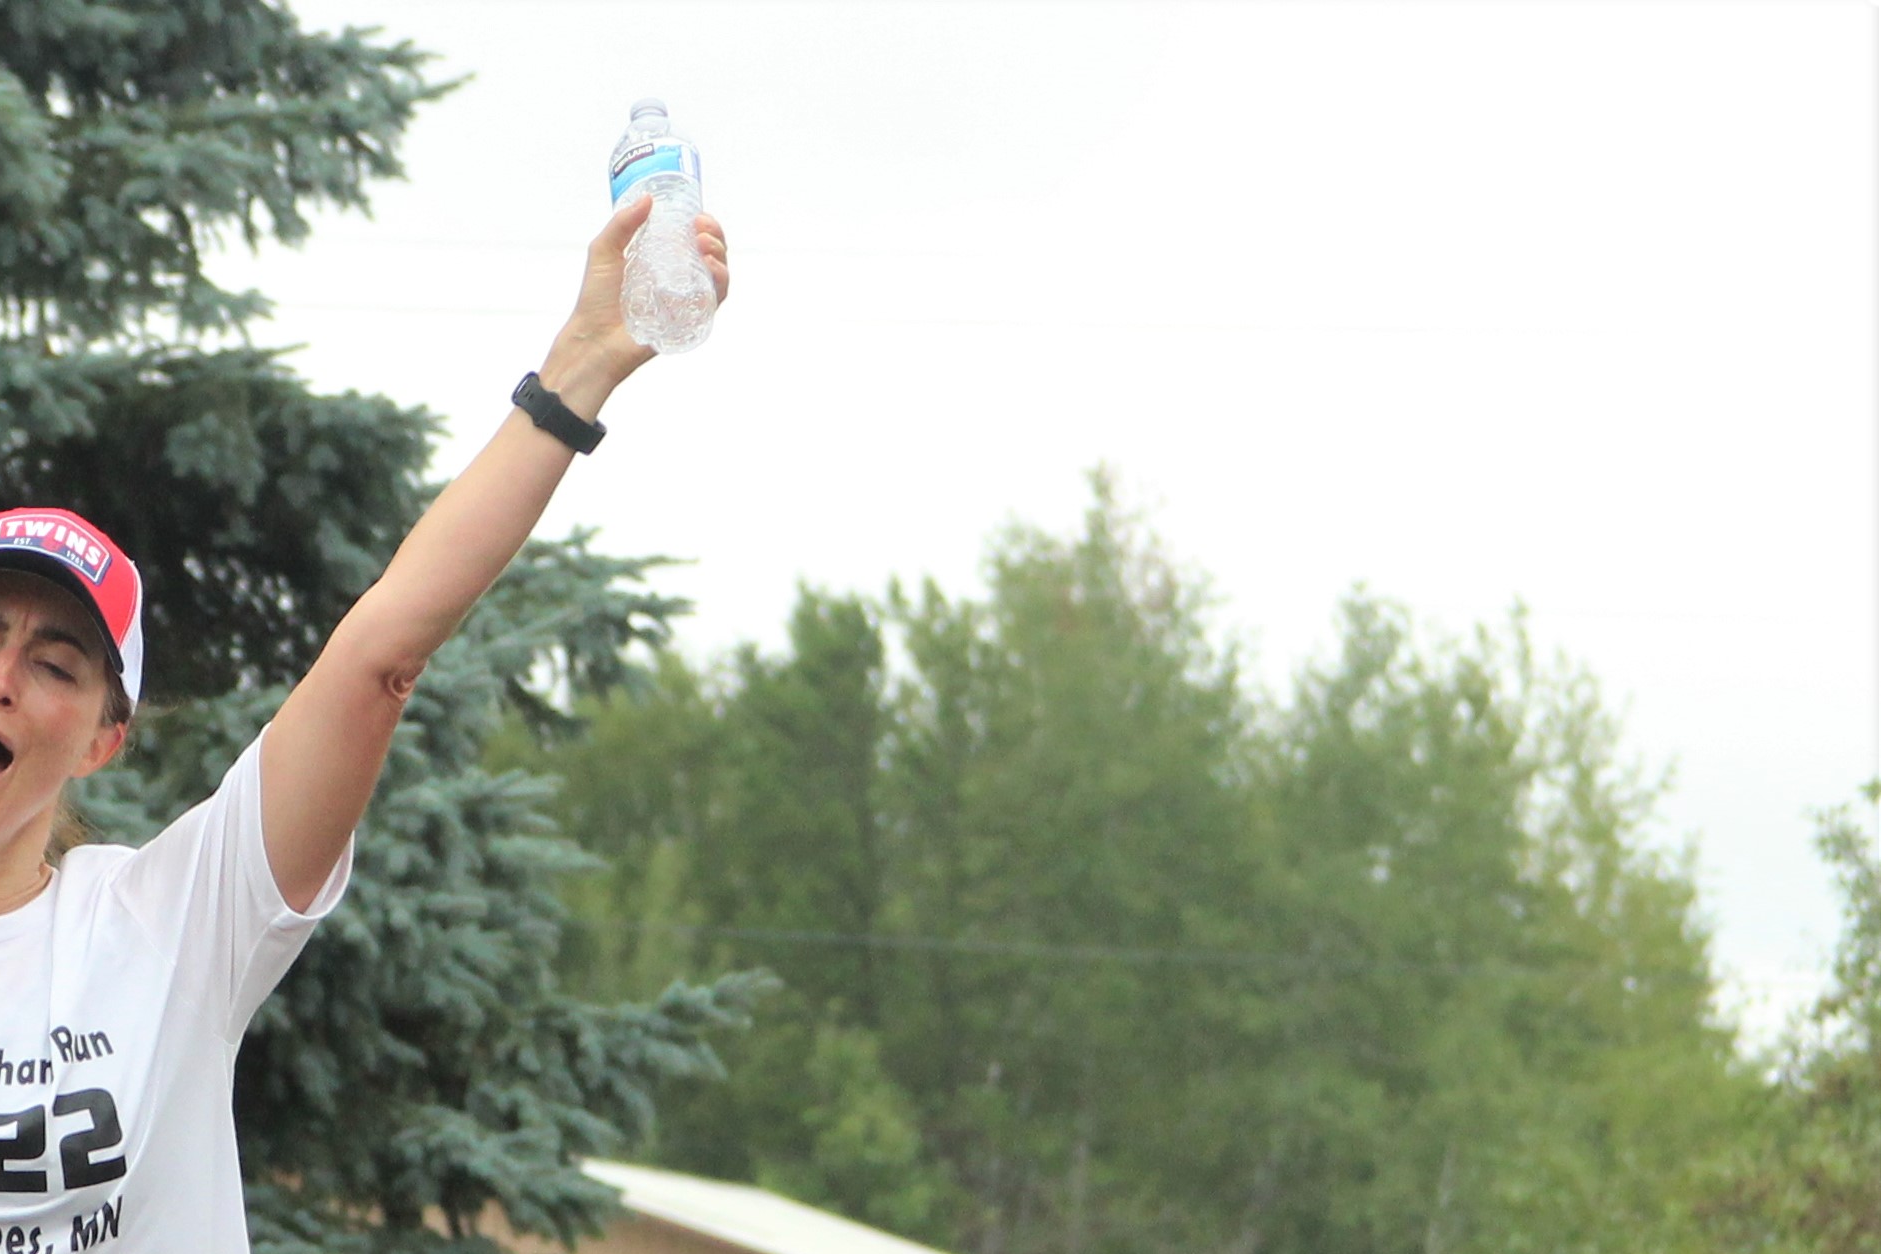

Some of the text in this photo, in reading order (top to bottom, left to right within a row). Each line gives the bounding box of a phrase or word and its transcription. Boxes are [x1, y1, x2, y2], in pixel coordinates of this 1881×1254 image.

[6, 520, 102, 566] TWINS
[50, 1025, 114, 1063] Run
[70, 1194, 123, 1252] MN
